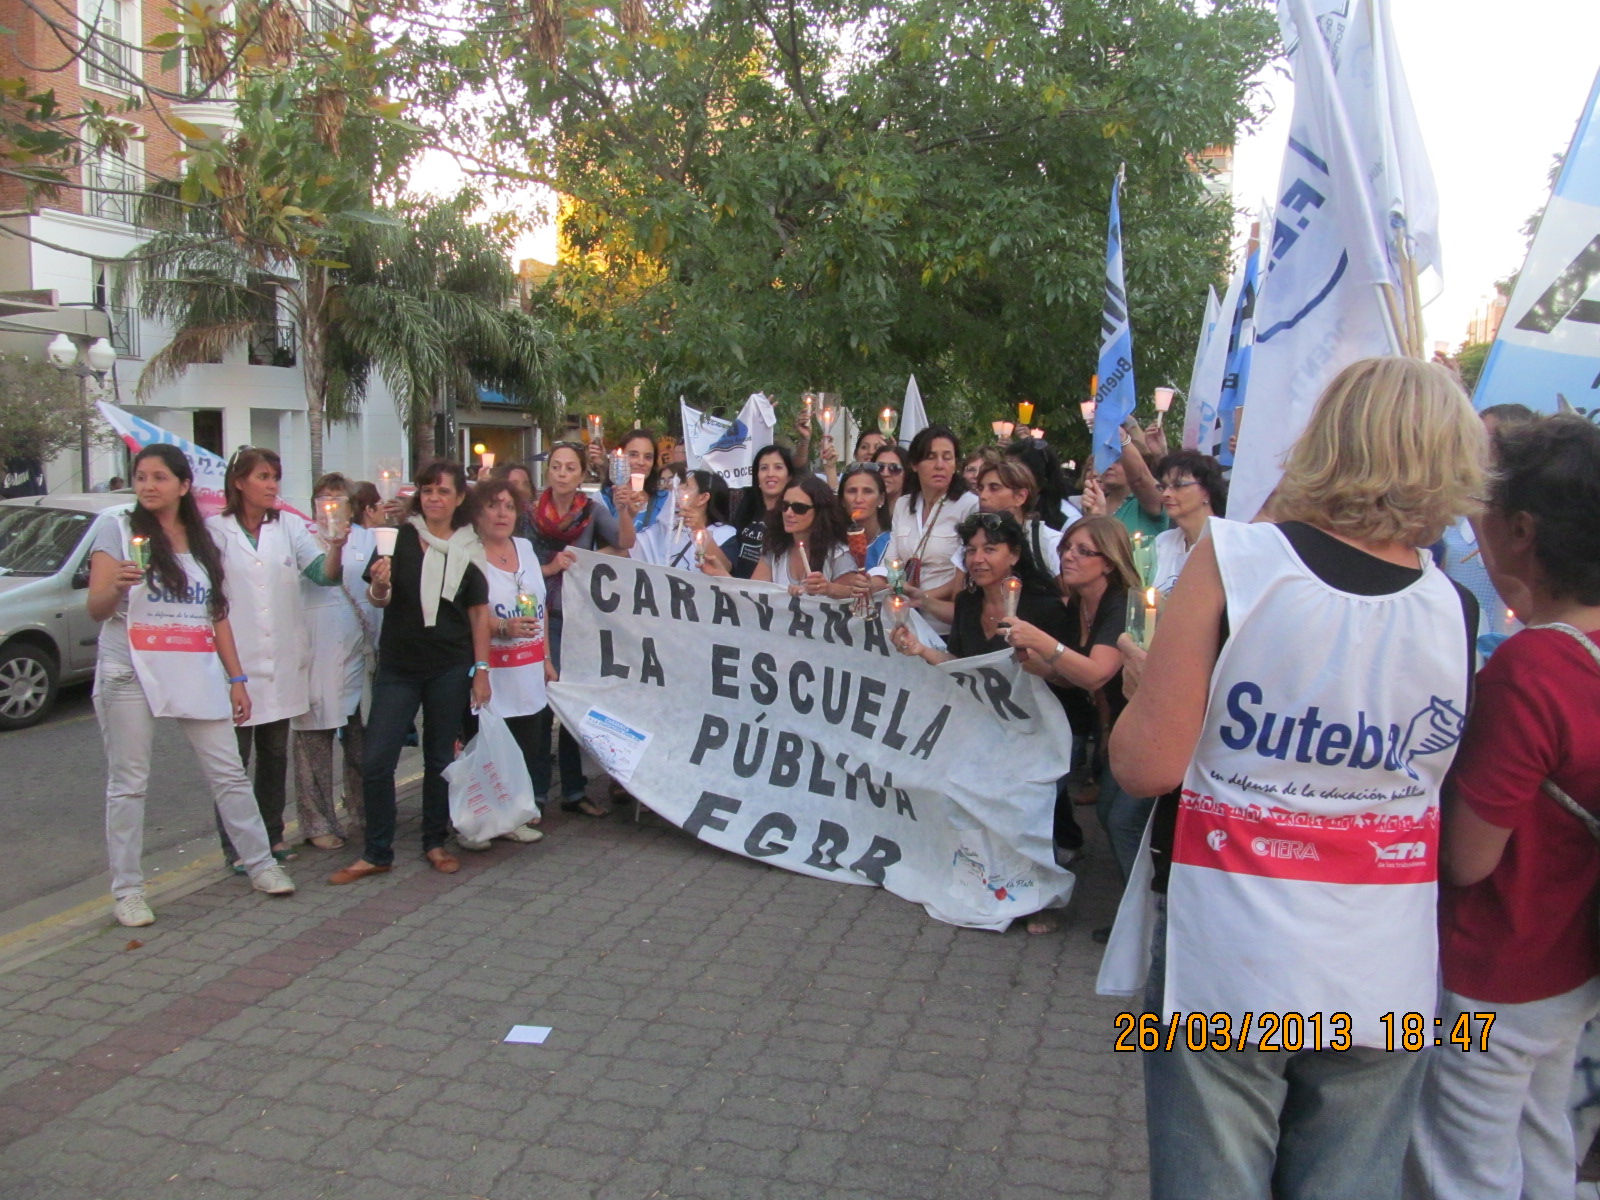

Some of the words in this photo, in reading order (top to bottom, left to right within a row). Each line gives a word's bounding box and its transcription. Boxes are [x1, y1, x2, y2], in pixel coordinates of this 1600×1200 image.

[733, 465, 753, 478] DOCE
[590, 563, 890, 656] CARAVANA
[600, 630, 665, 687] LA
[711, 643, 952, 761] ESCUELA
[689, 711, 918, 821] PÚBLICA
[1282, 780, 1298, 795] de
[1301, 783, 1316, 798] la
[1250, 837, 1319, 861] CTERA
